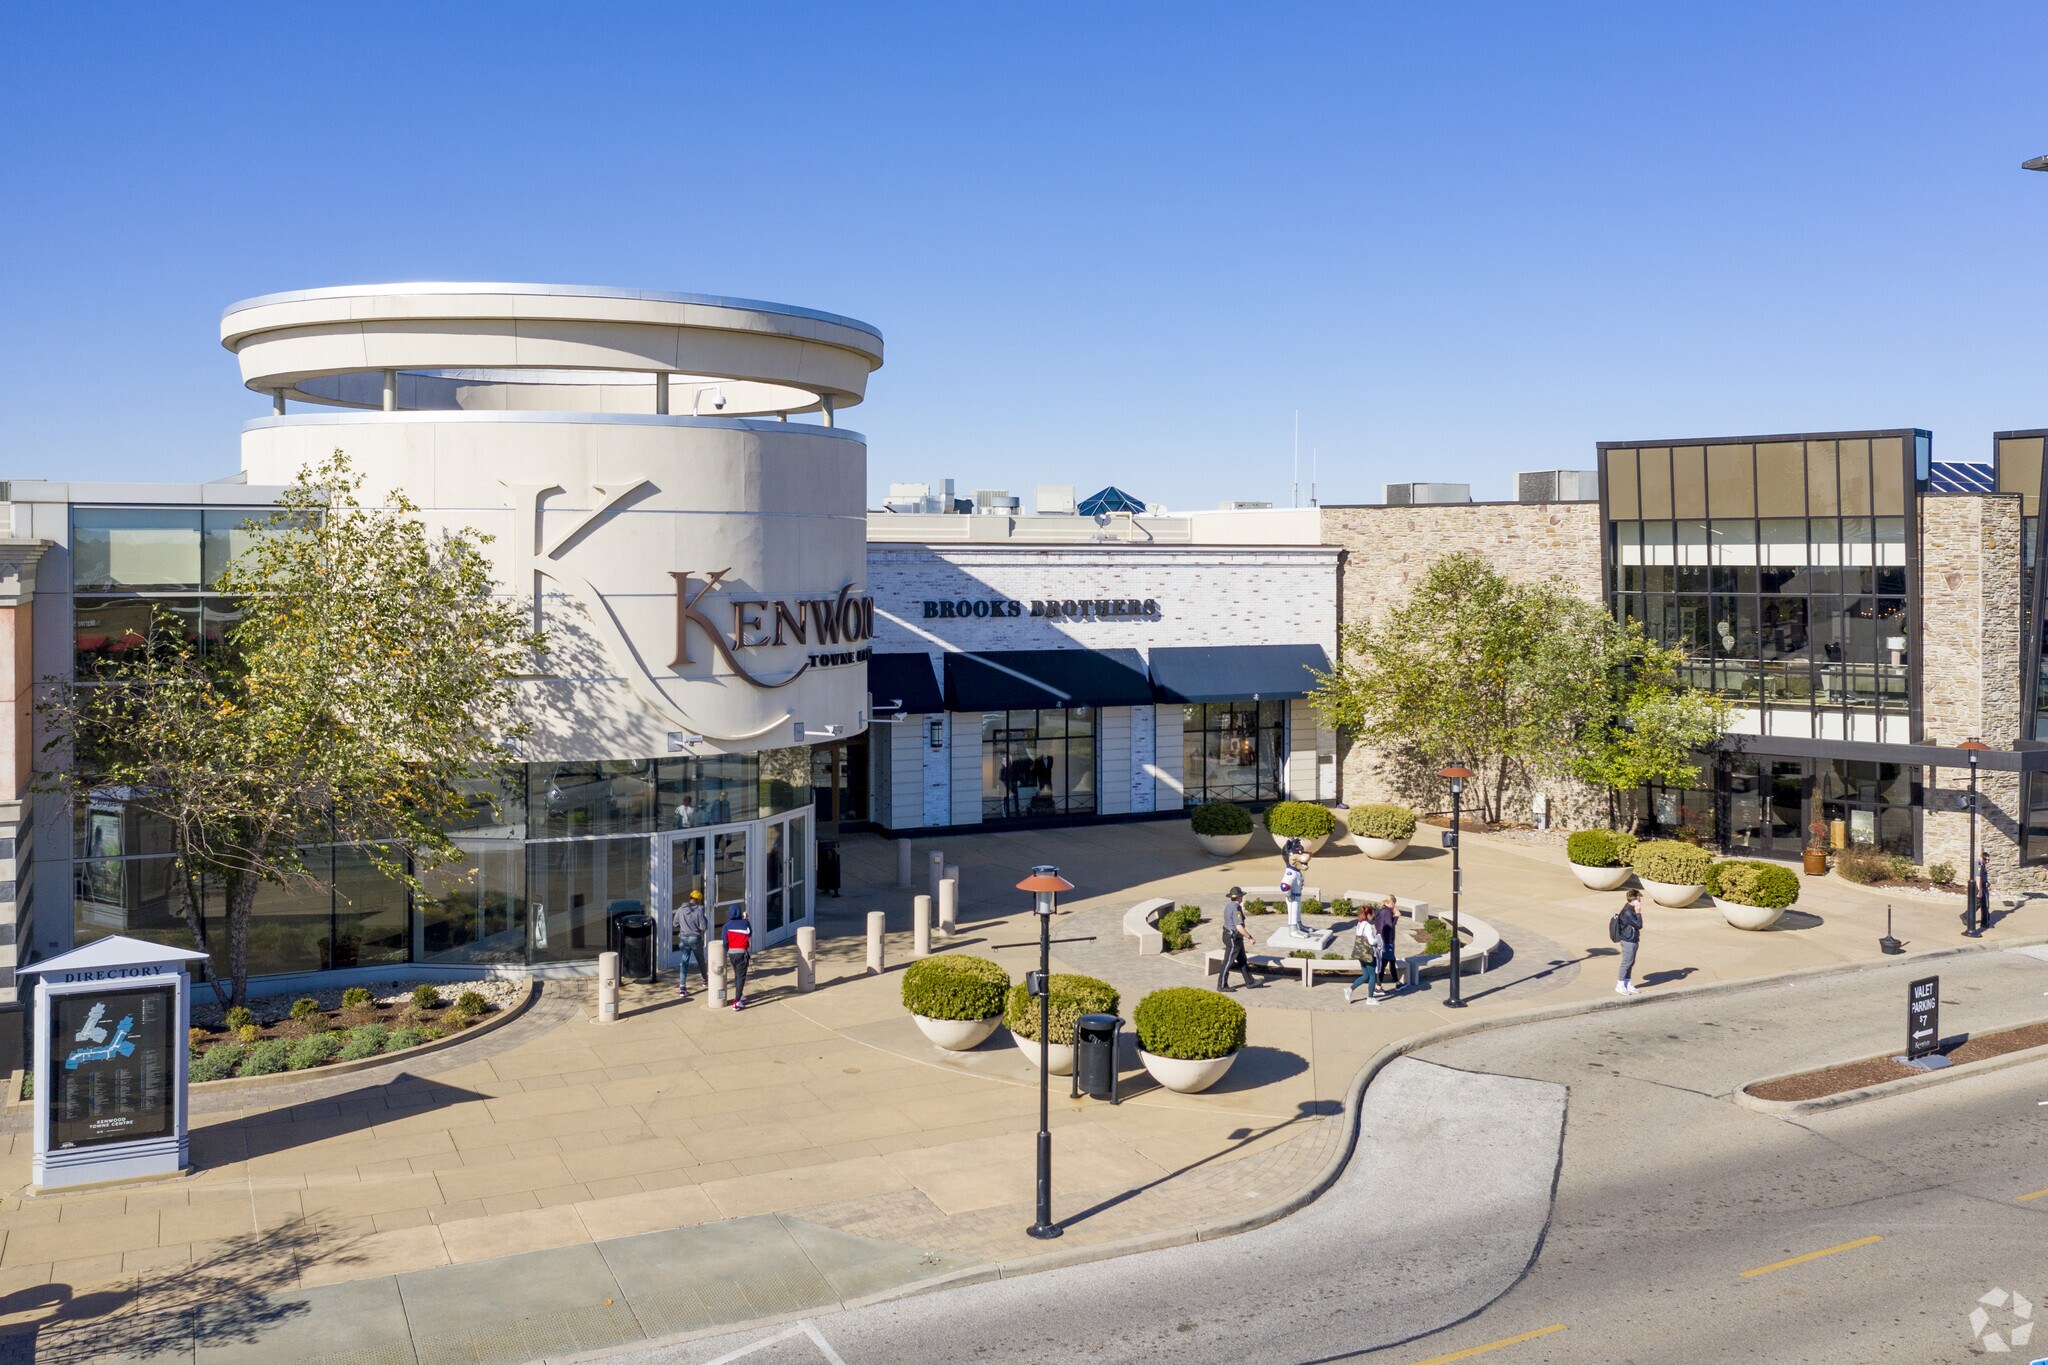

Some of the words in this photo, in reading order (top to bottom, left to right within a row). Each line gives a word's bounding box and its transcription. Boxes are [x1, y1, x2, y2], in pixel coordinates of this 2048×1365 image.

[923, 600, 1022, 619] BROOKS
[1030, 599, 1157, 617] BROTHERS
[808, 651, 855, 668] TOWNE
[65, 965, 163, 983] DIRECTORY
[1914, 983, 1934, 999] VALET
[1911, 998, 1936, 1014] PARKING
[1919, 1015, 1928, 1026] $7
[96, 1117, 126, 1125] KENWOOD
